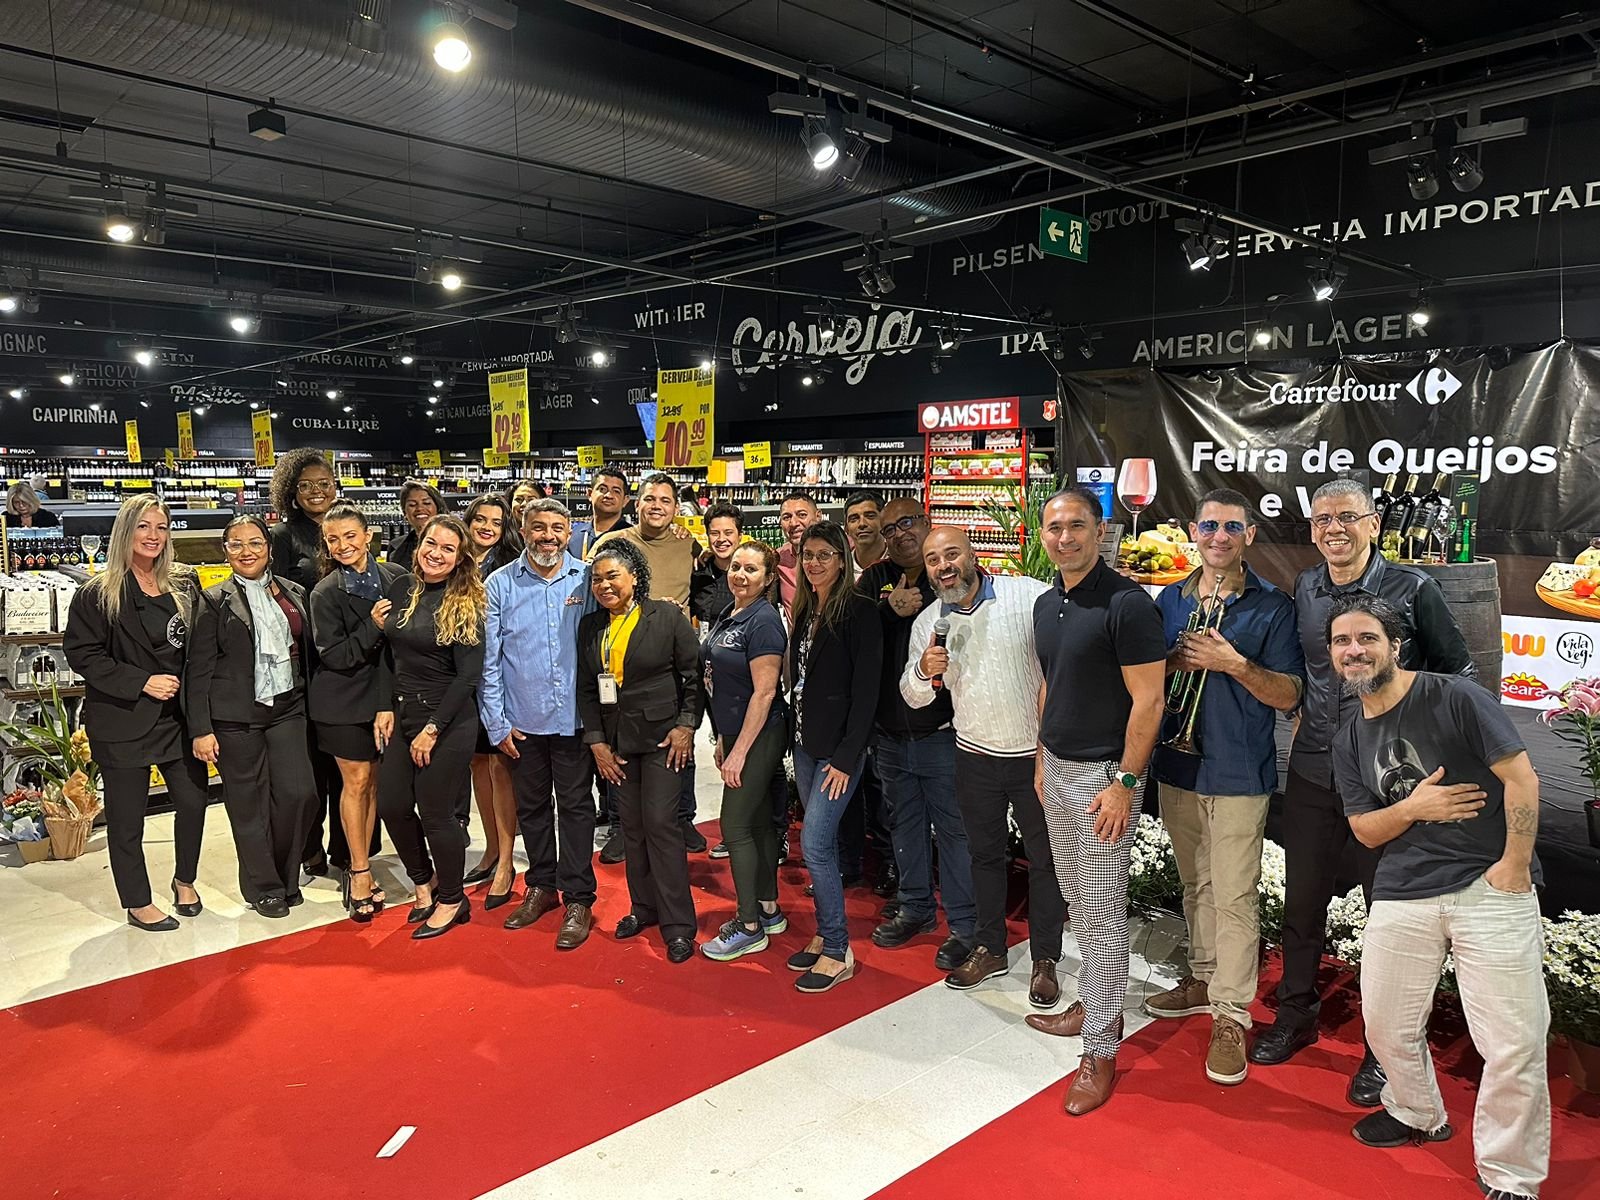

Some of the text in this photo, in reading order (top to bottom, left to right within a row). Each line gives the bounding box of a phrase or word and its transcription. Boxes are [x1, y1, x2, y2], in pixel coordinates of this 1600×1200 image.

[1088, 200, 1171, 233] STOUT
[952, 242, 1045, 276] PILSEN
[633, 302, 706, 329] WITIER
[0, 333, 47, 354] GNAC
[731, 303, 923, 385] Cerveja
[999, 331, 1049, 356] IPA
[1132, 313, 1428, 363] AMERICAN LAGER
[1268, 377, 1402, 406] Carrefour
[32, 407, 118, 424] CAIPIRINHA
[939, 401, 1012, 428] AMSTEL
[1191, 434, 1559, 484] Feira de Queijos
[1259, 492, 1283, 518] e
[7, 610, 49, 618] Budweiser
[1563, 635, 1589, 650] vida
